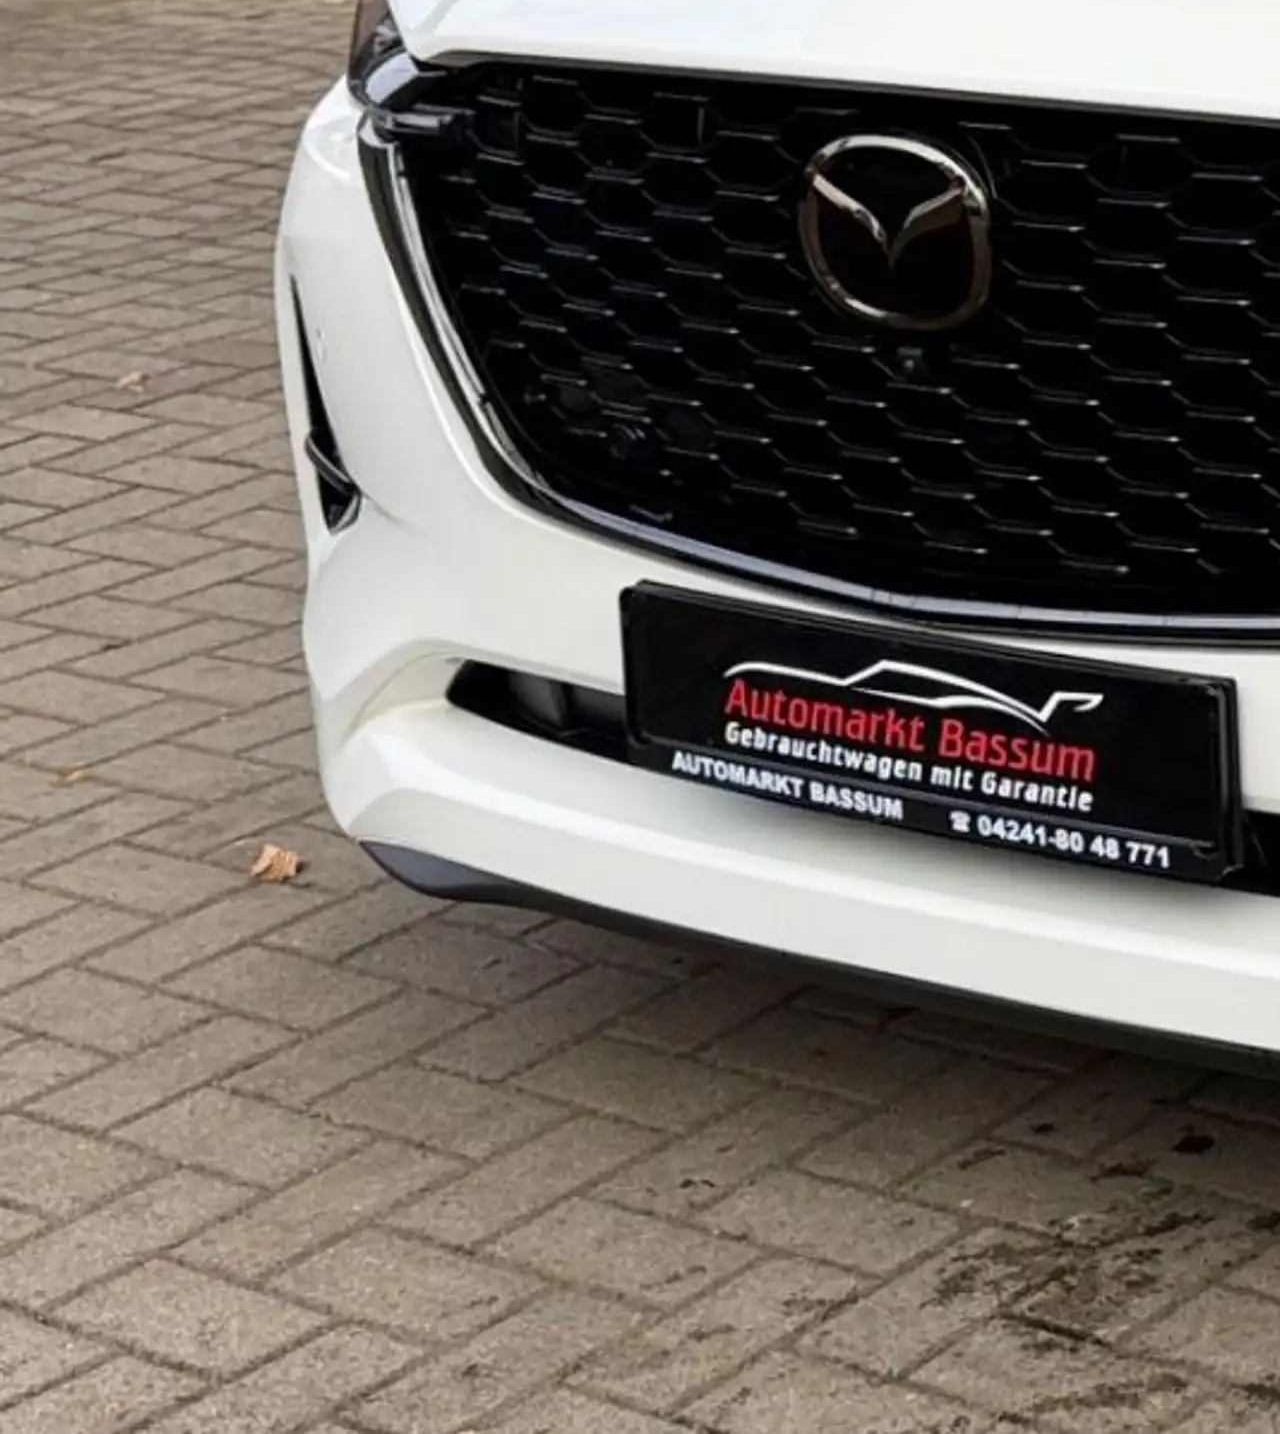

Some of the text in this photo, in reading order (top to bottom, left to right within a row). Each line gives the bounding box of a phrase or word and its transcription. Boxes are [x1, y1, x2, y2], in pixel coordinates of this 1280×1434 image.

[724, 720, 1094, 813] Gebrauchtwagen mit Garantie
[725, 677, 1095, 783] Automarkt Bassum
[671, 749, 904, 822] AUTOMARKT BASSUM
[976, 814, 1170, 869] 04241-80 48 771
